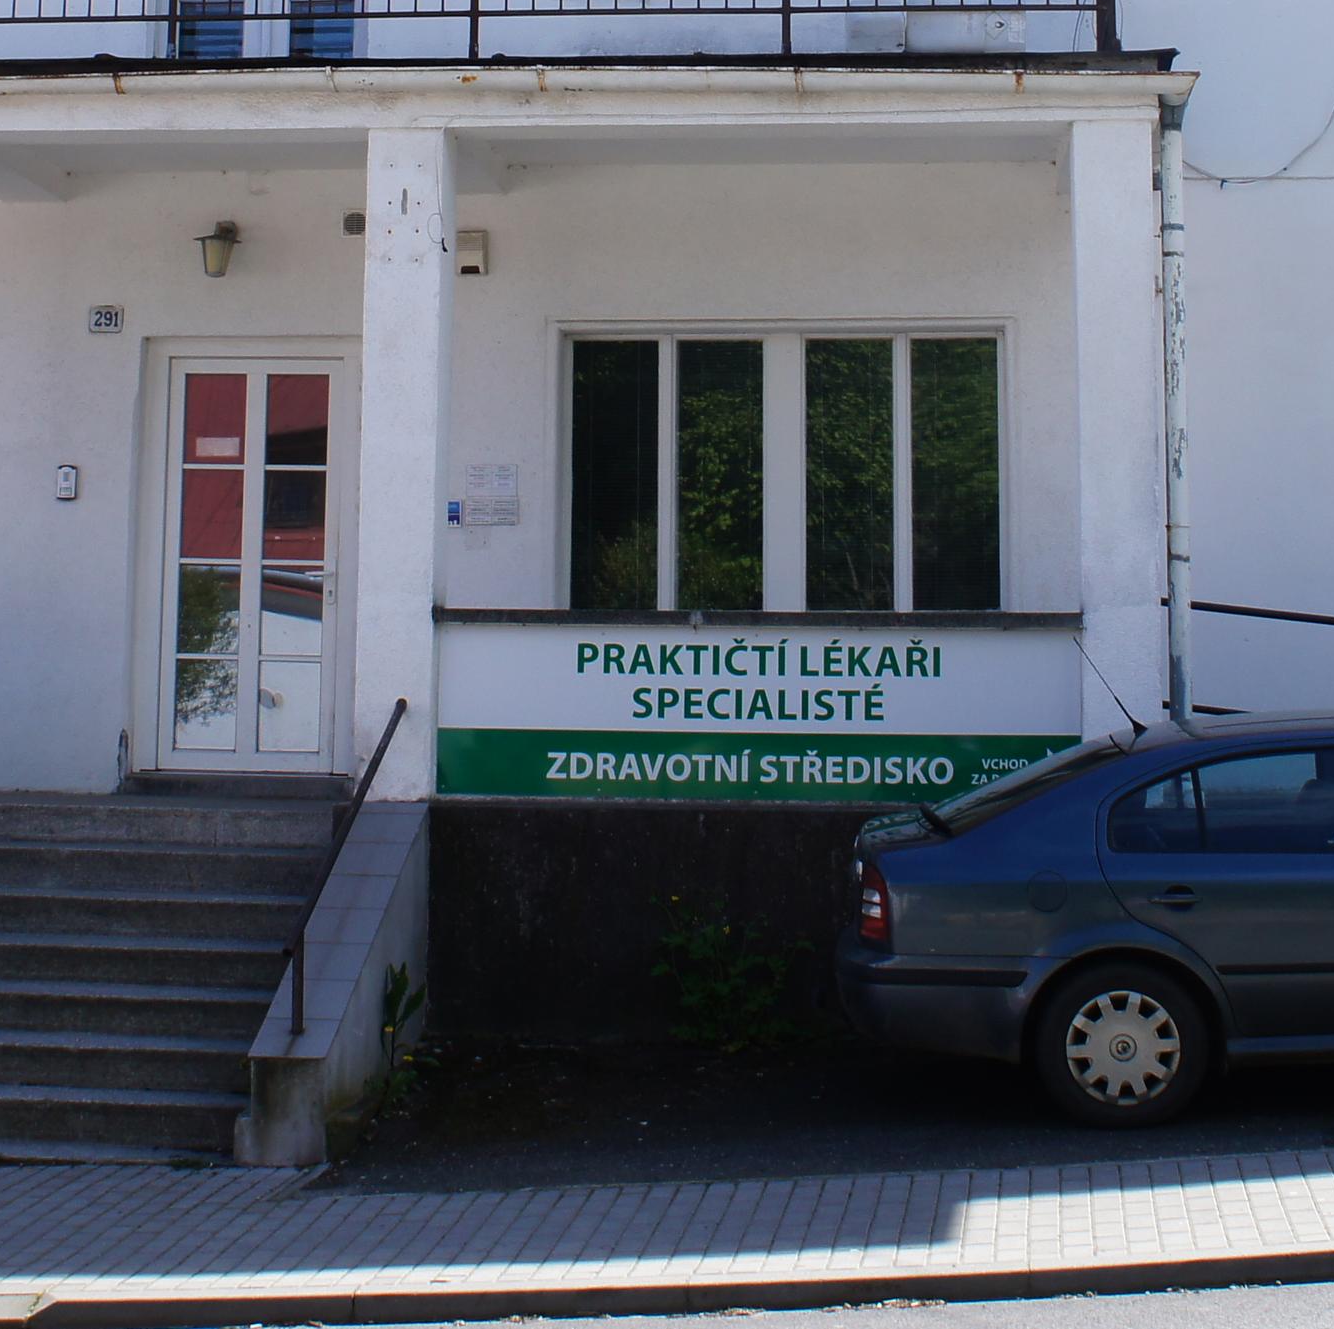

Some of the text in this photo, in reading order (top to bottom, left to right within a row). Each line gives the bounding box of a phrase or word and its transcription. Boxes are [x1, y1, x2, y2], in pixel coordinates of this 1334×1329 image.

[94, 310, 119, 328] 291
[576, 637, 942, 679] PRAKTIČTÍ LÉKAŘI
[632, 682, 886, 723] SPECIALISTÉ
[546, 749, 955, 785] ZDRAVOTNÍ STŘEDISKO
[981, 758, 1028, 770] VCHOD
[971, 773, 988, 785] ZA
